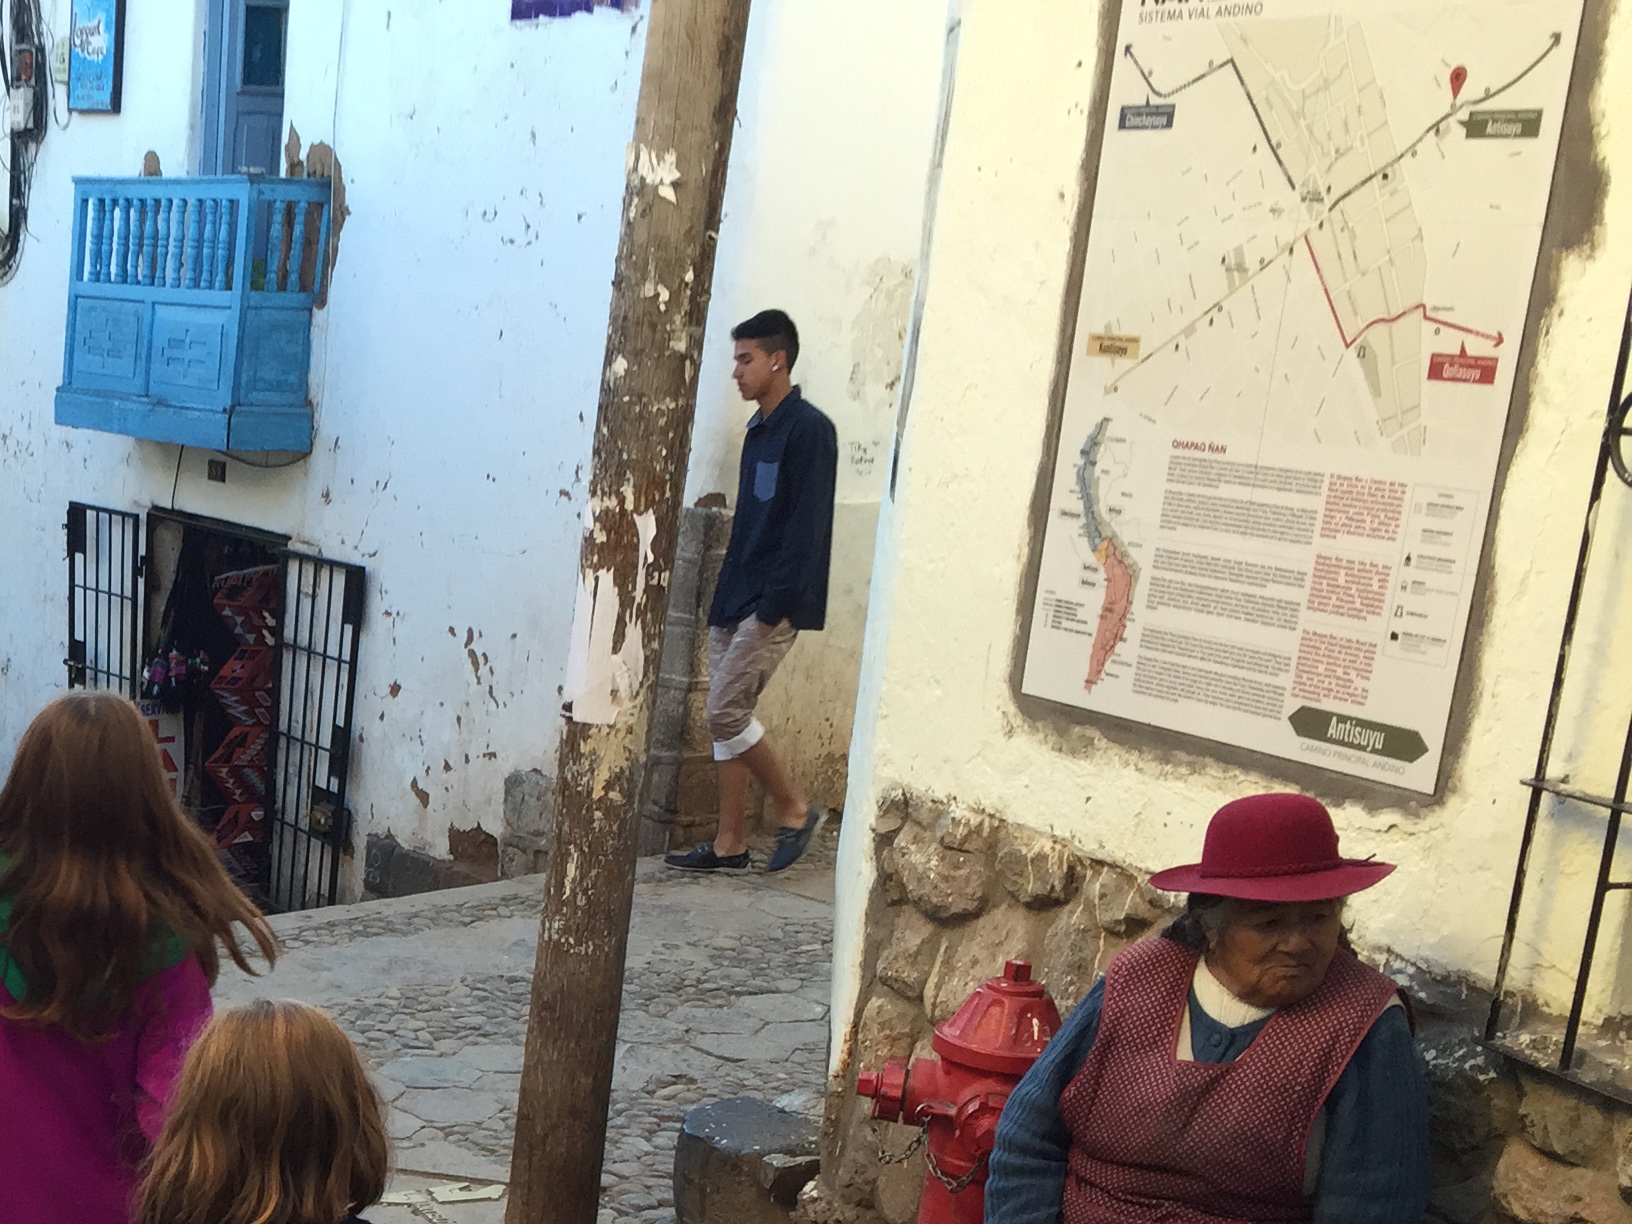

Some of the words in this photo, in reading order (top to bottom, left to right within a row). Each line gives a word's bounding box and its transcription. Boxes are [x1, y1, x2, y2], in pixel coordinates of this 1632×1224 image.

[1138, 8, 1184, 26] SISTEMA
[1188, 6, 1211, 20] VIAL
[1215, 2, 1264, 19] ANDINO
[1171, 438, 1207, 452] QHAPAQ
[1327, 715, 1386, 751] Antisuyu
[1300, 742, 1330, 757] CAMINO
[1332, 749, 1369, 767] PRINCIPAL
[1371, 758, 1406, 775] ANDINO
